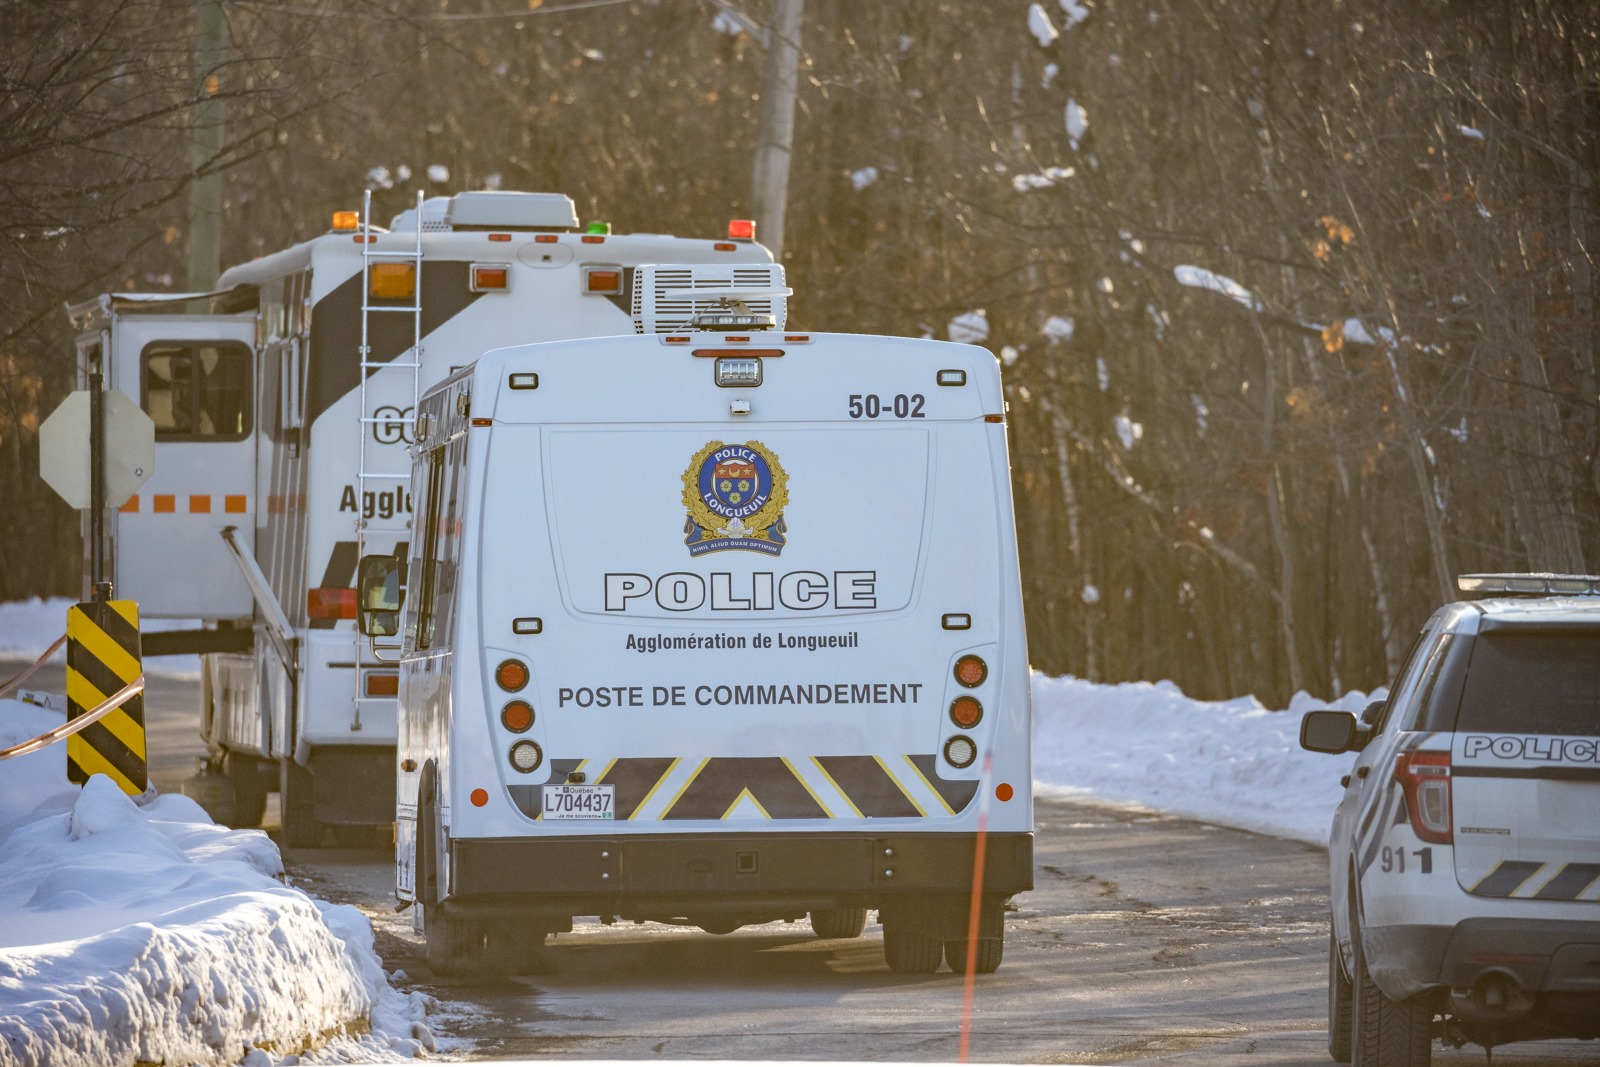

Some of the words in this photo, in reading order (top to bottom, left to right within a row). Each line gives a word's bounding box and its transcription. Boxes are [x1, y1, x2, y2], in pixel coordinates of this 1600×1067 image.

[848, 393, 926, 419] 50-02
[714, 448, 757, 463] POLICE
[703, 492, 767, 518] LONGUEUIL
[692, 544, 709, 553] NIHIL
[710, 541, 729, 549] ALIUD
[749, 541, 779, 553] OPTIMUM
[604, 571, 877, 612] POLICE
[625, 632, 747, 654] Agglomération
[752, 632, 772, 649] de
[778, 631, 859, 652] Longueuil
[558, 686, 644, 708] POSTE
[652, 686, 687, 706] DE
[694, 683, 923, 706] COMMANDEMENT
[1464, 735, 1600, 764] POLIC
[545, 793, 612, 812] L704437
[1381, 845, 1433, 874] 911
